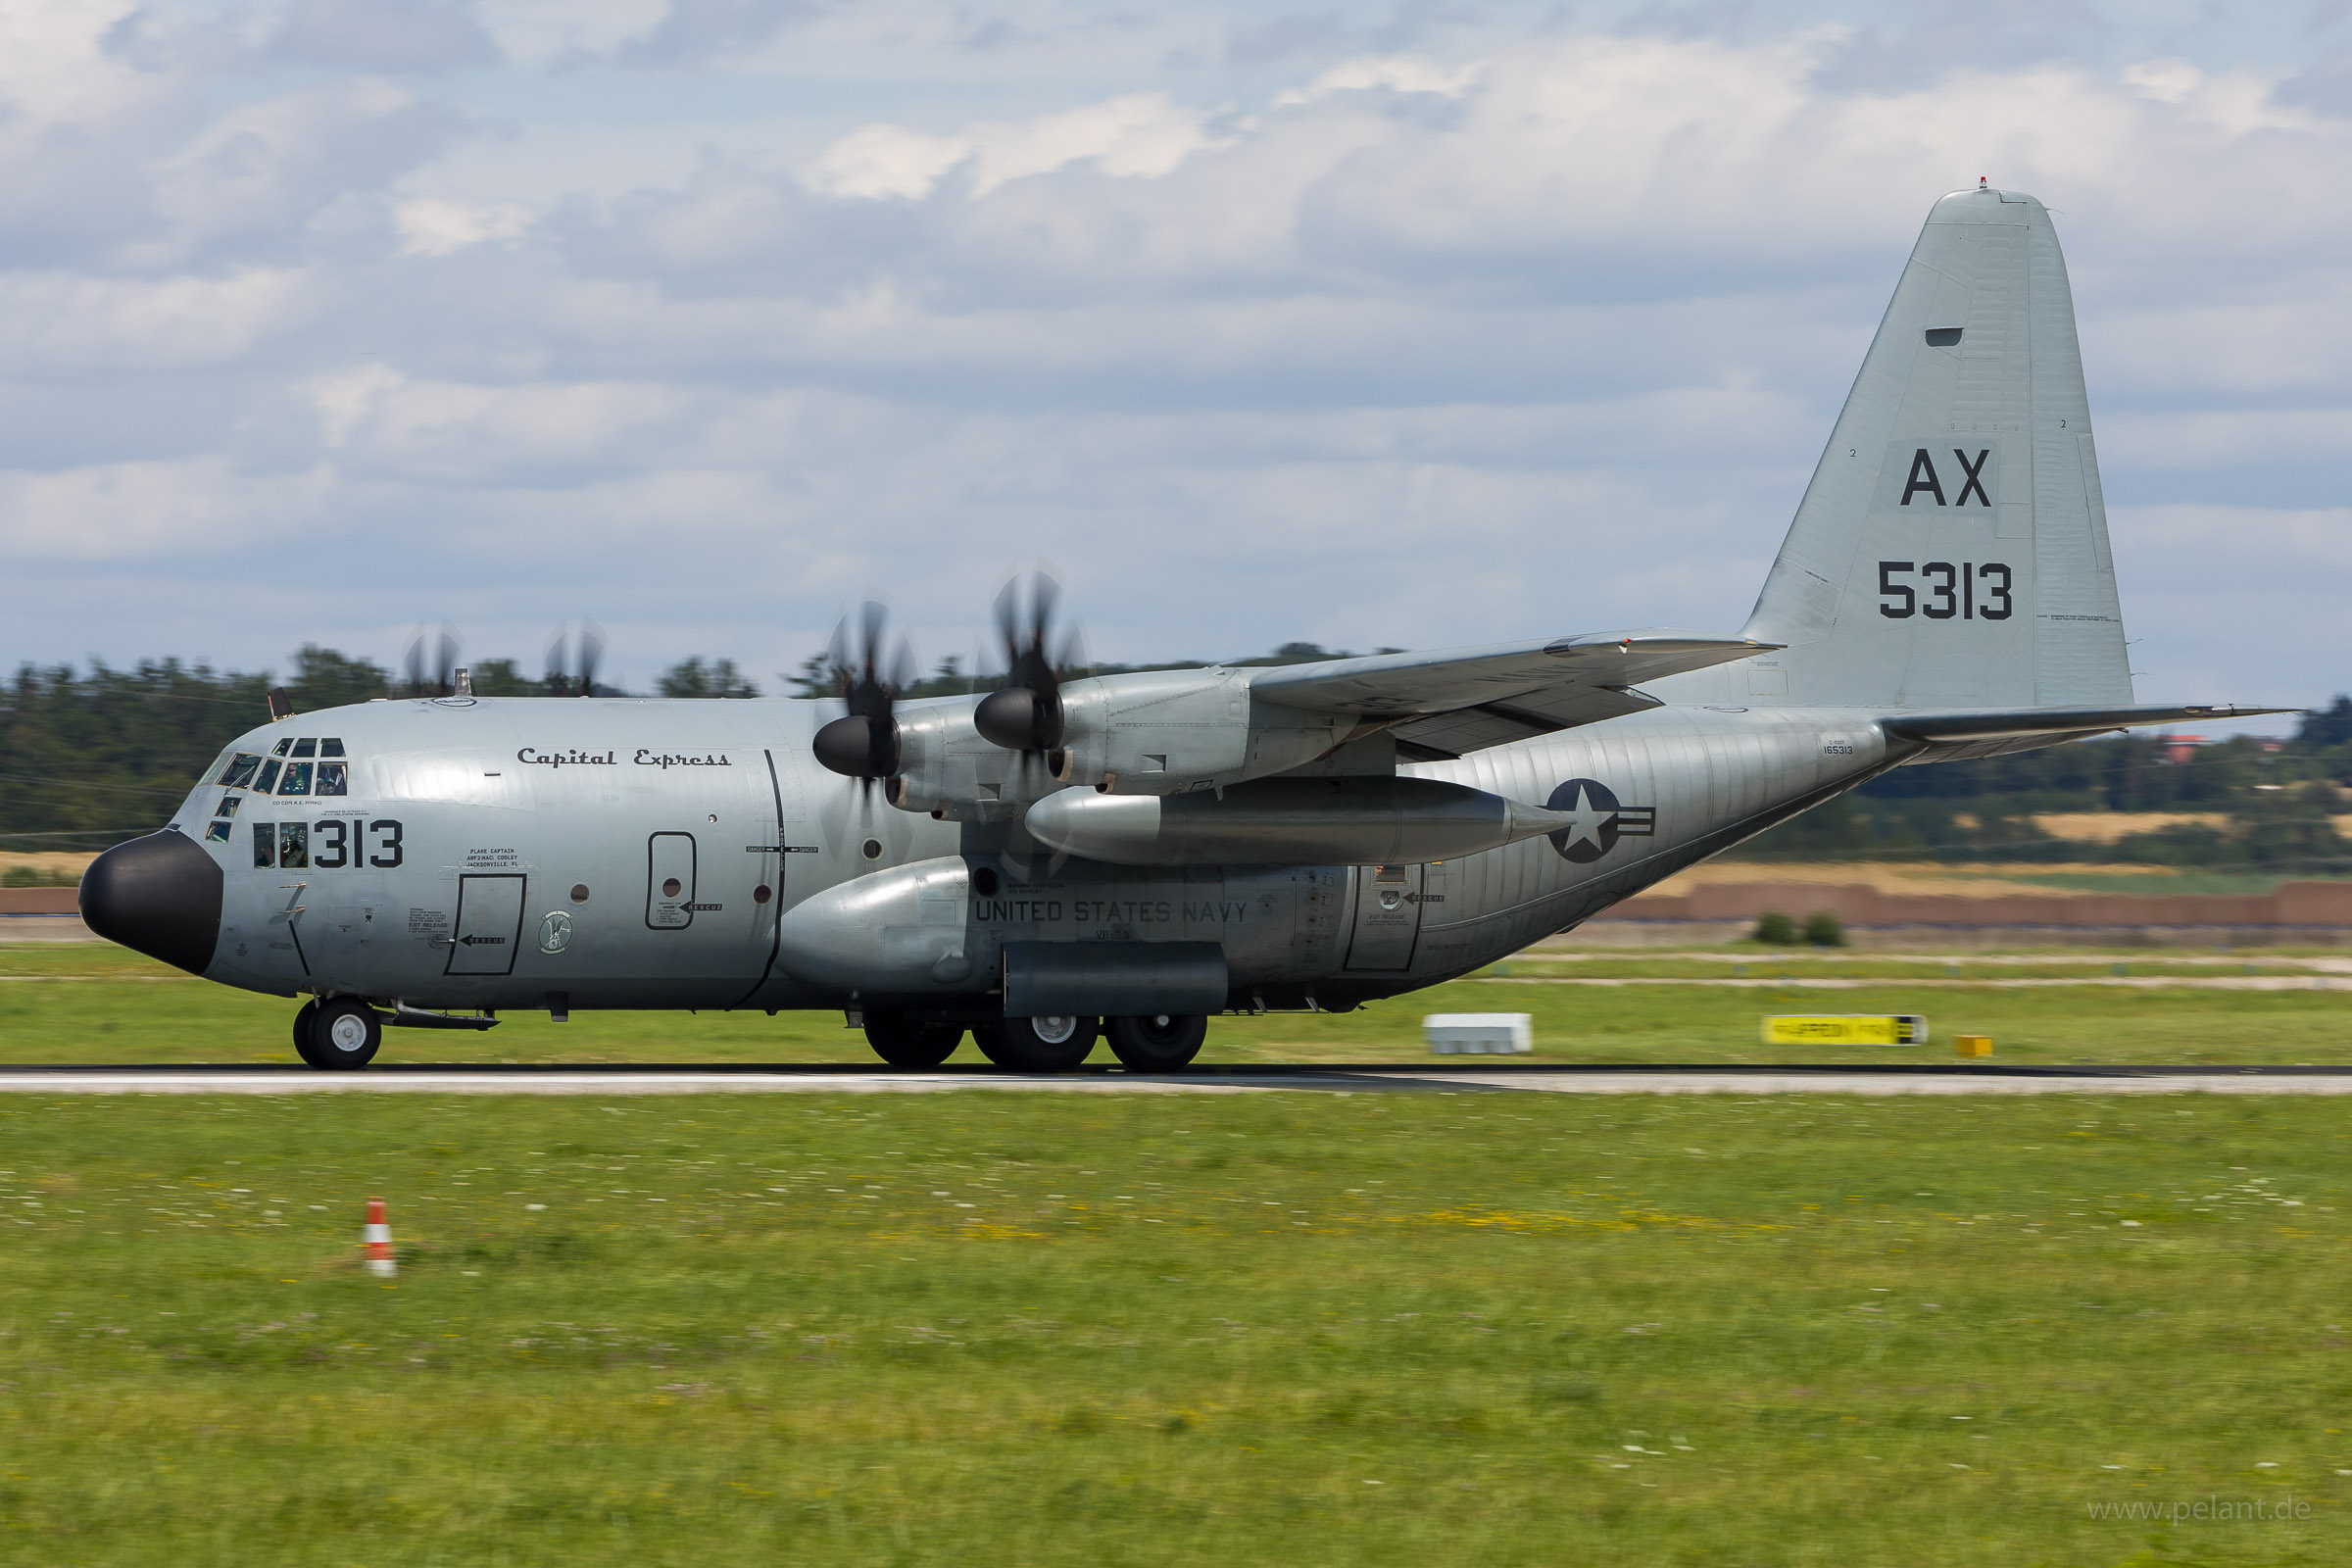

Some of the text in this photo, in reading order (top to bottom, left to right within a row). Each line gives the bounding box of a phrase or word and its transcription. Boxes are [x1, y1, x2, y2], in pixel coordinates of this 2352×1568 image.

[1849, 448, 1857, 458] 2
[1899, 448, 1992, 508] AX
[1879, 561, 2012, 620] 5313
[516, 748, 732, 770] Capital Express
[1824, 745, 1853, 755] 165313
[314, 819, 404, 869] 313
[976, 901, 1248, 923] UNITED STATES NAVY
